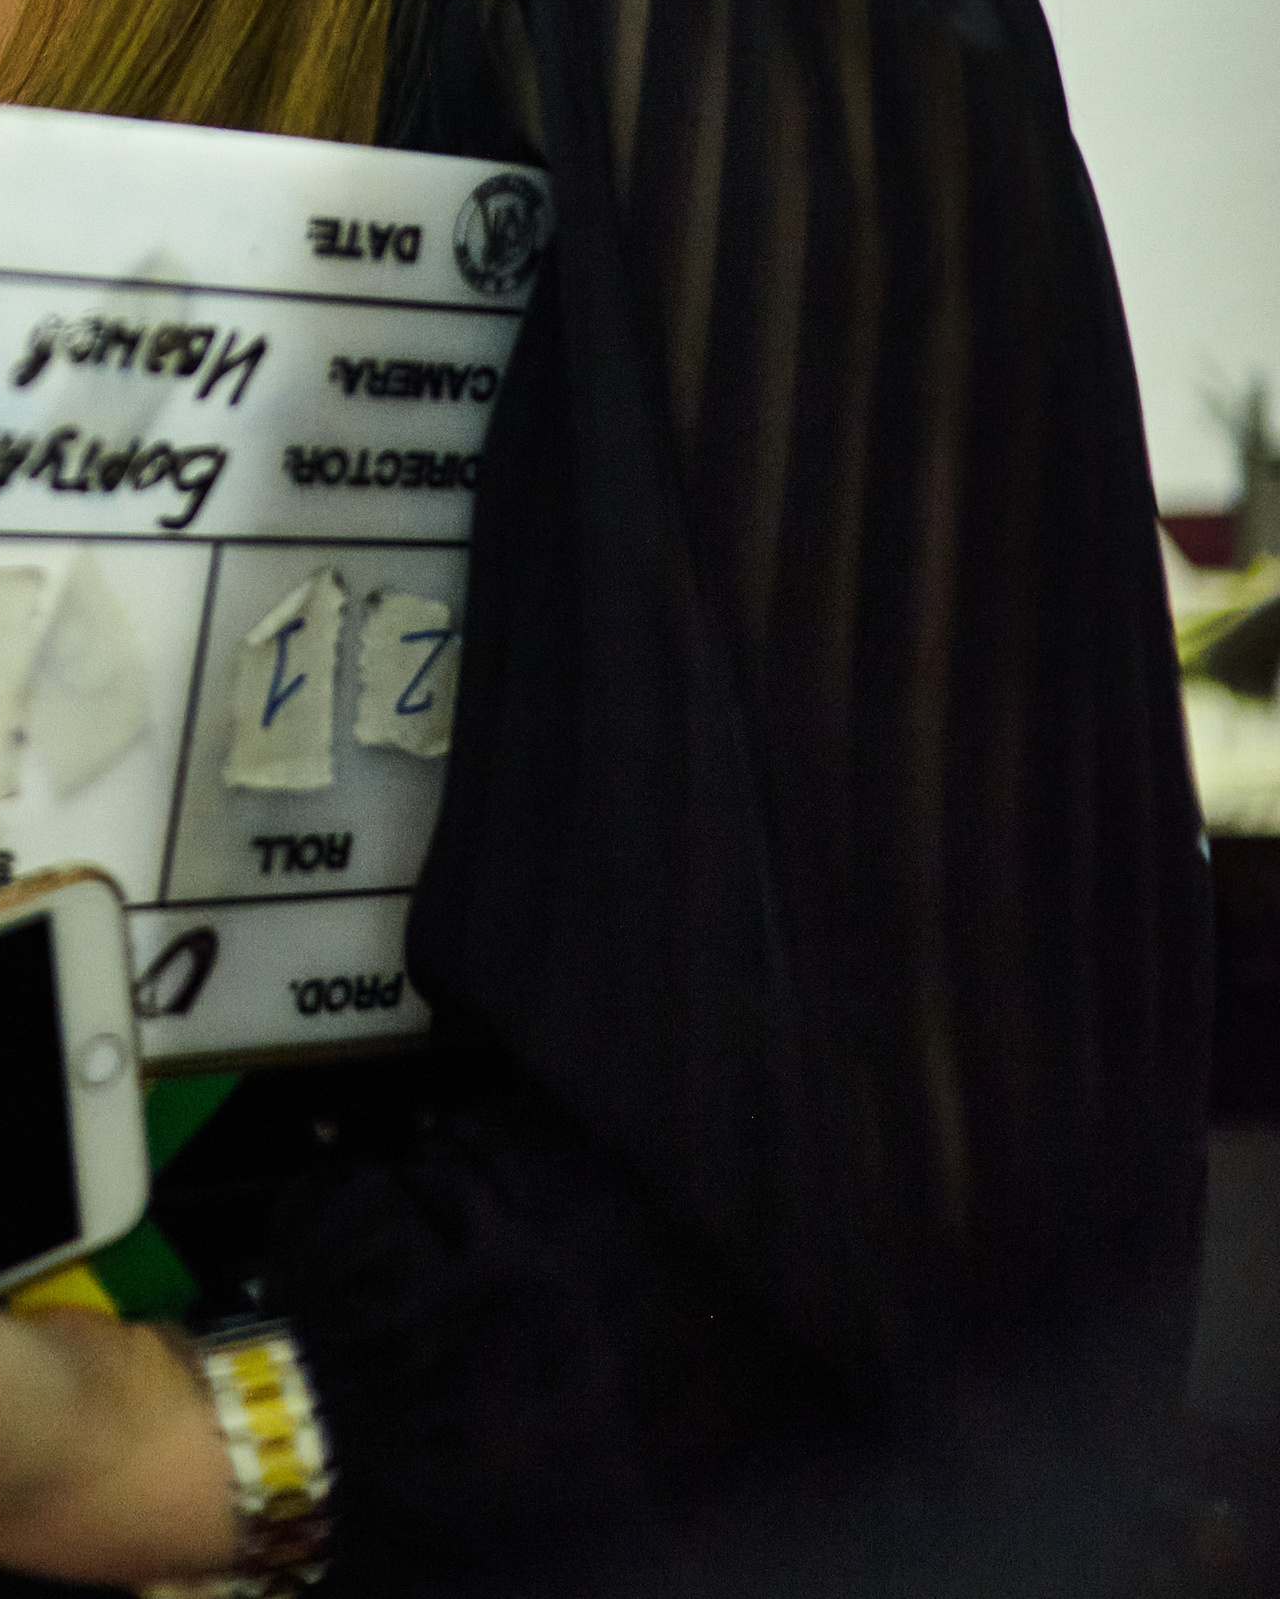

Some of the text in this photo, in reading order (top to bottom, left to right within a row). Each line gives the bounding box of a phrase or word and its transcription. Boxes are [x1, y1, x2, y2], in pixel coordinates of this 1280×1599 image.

[305, 215, 422, 265] DATE:
[326, 355, 498, 404] CAMERA:
[281, 444, 482, 491] DIRECTOR:
[249, 829, 353, 877] ROLL
[287, 969, 405, 1018] PROD.
